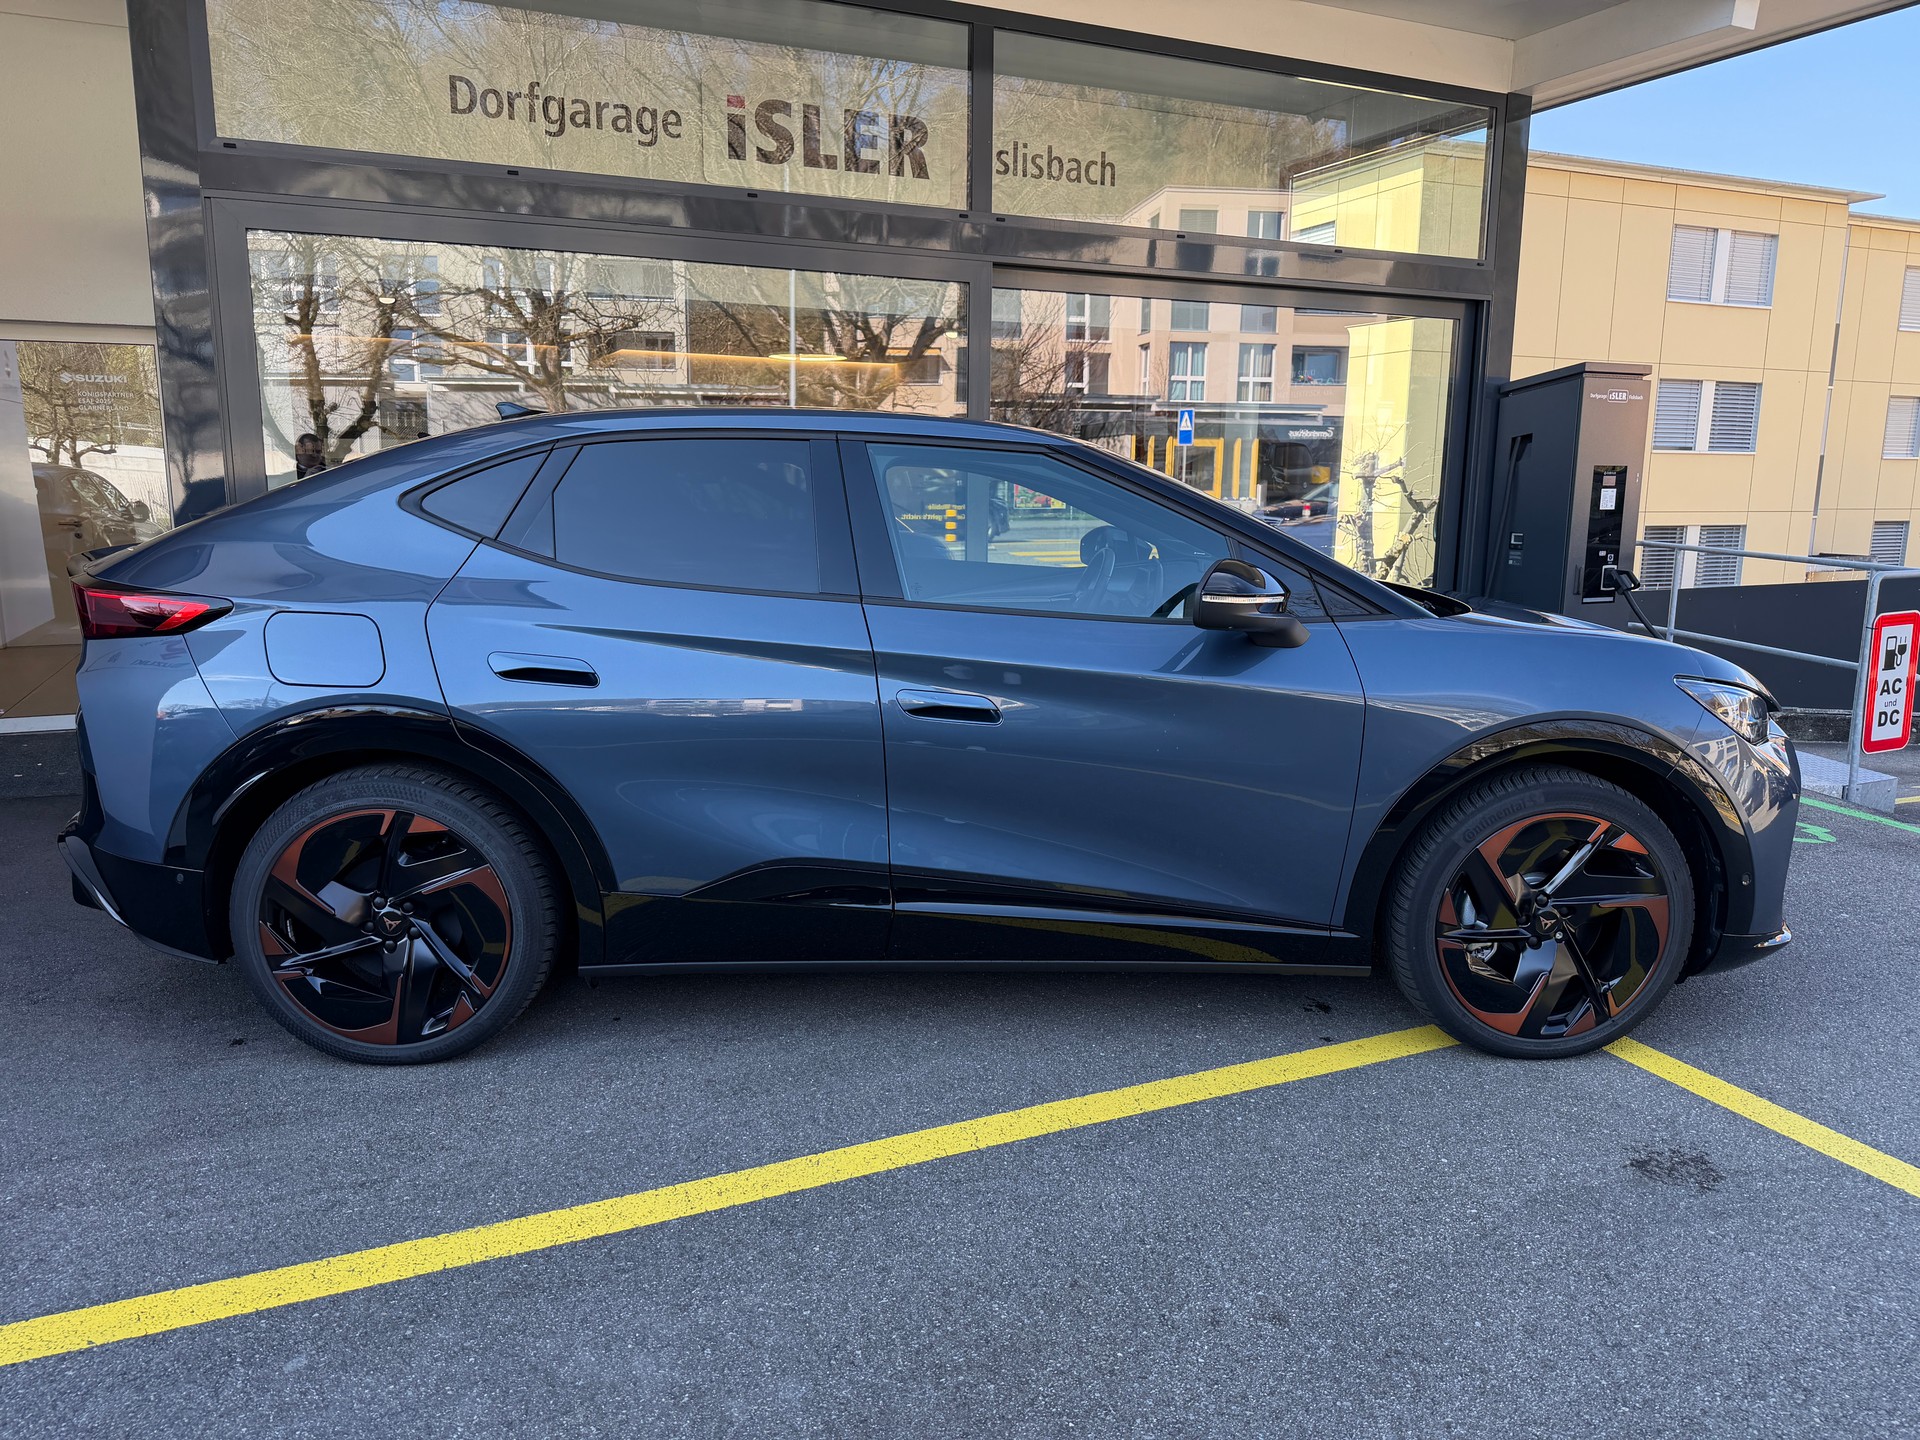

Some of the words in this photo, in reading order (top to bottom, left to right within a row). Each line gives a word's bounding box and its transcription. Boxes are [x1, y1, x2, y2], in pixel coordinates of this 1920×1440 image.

[448, 74, 683, 147] Dorfgarage
[995, 141, 1116, 187] slisbach
[75, 374, 128, 383] SUZUKI
[1879, 677, 1902, 696] AC
[1884, 698, 1898, 708] und
[1877, 709, 1900, 727] DC
[1462, 803, 1527, 843] Continental
